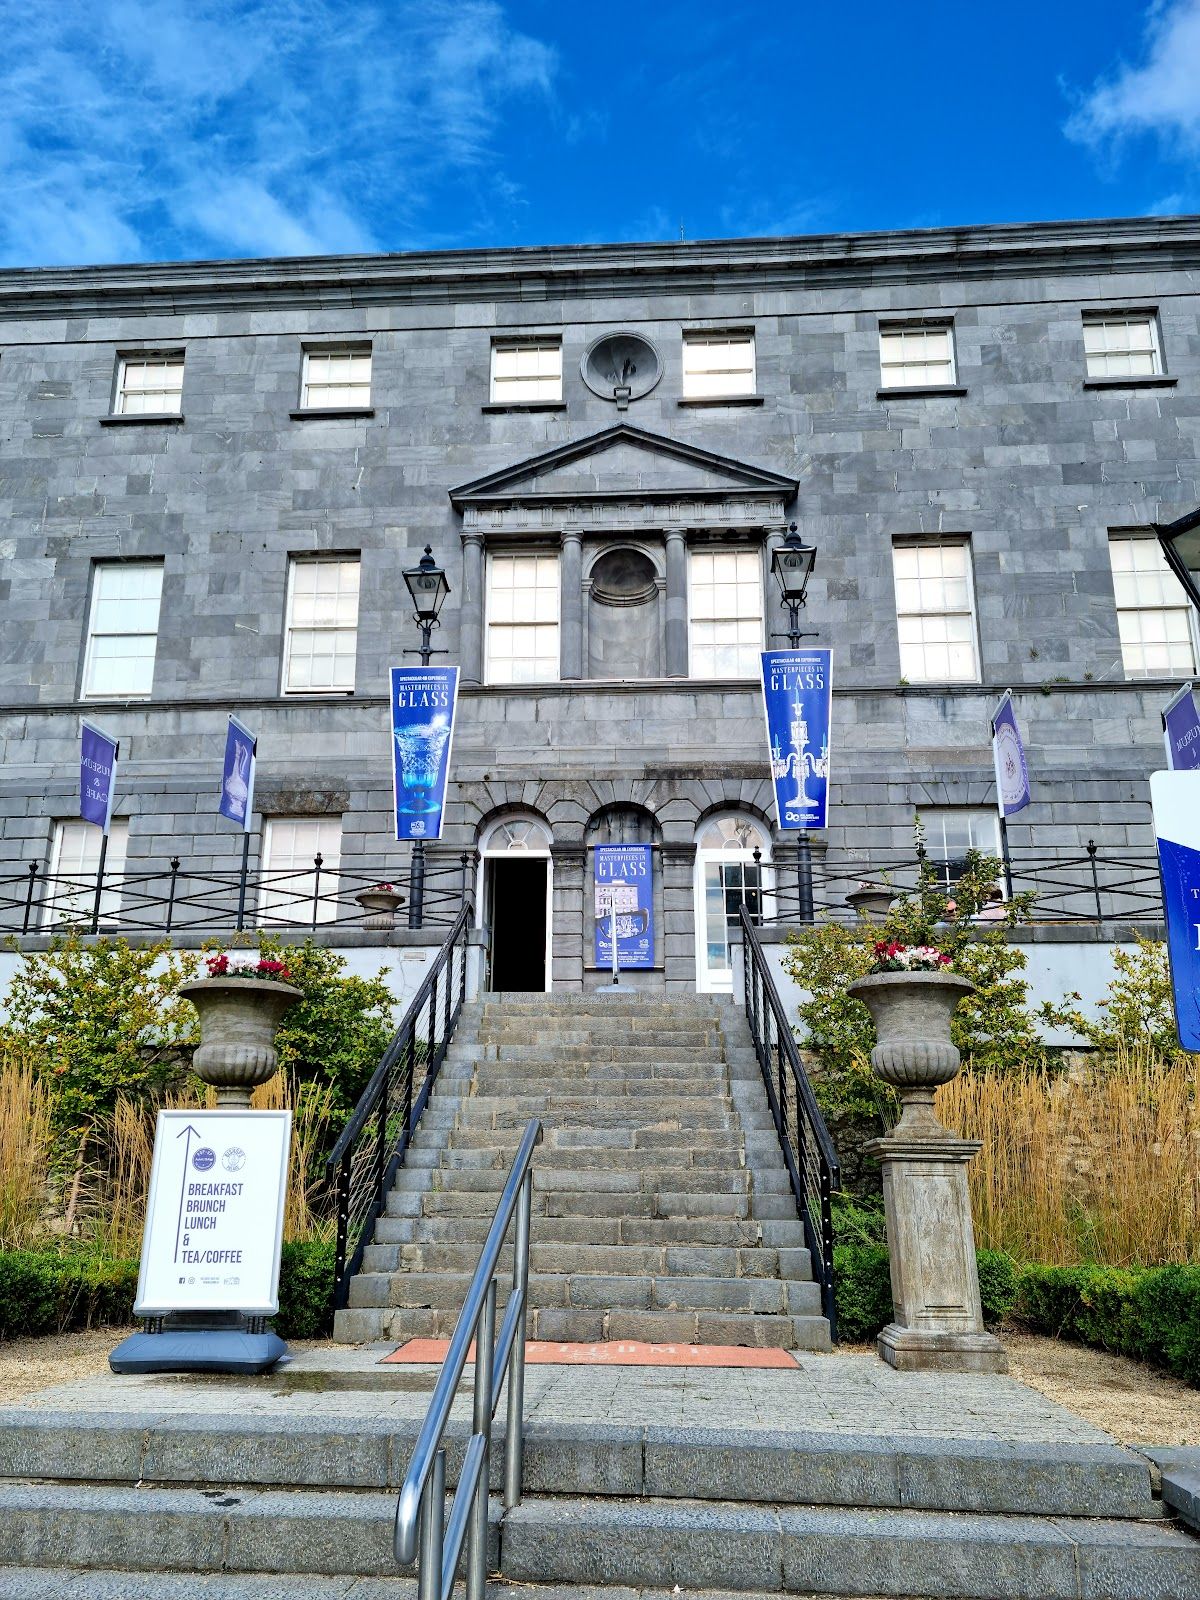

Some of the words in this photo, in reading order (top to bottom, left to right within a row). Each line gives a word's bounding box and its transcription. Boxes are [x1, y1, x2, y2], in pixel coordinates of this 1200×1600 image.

[771, 665, 815, 674] MASTERPIECES
[816, 665, 824, 673] IN
[399, 683, 441, 691] MASTERPIECES
[442, 683, 449, 691] IN
[771, 673, 824, 691] GLASS
[398, 691, 449, 708] GLASS
[599, 854, 639, 862] MASTERPIECES
[598, 862, 647, 877] GLASS
[188, 1183, 244, 1196] BREAKFAST
[186, 1199, 226, 1213] BRUNCH
[184, 1216, 217, 1230] LUNCH
[182, 1233, 190, 1247] &
[181, 1250, 243, 1264] TEA/COFFEE
[526, 1344, 711, 1355] ELCOME
